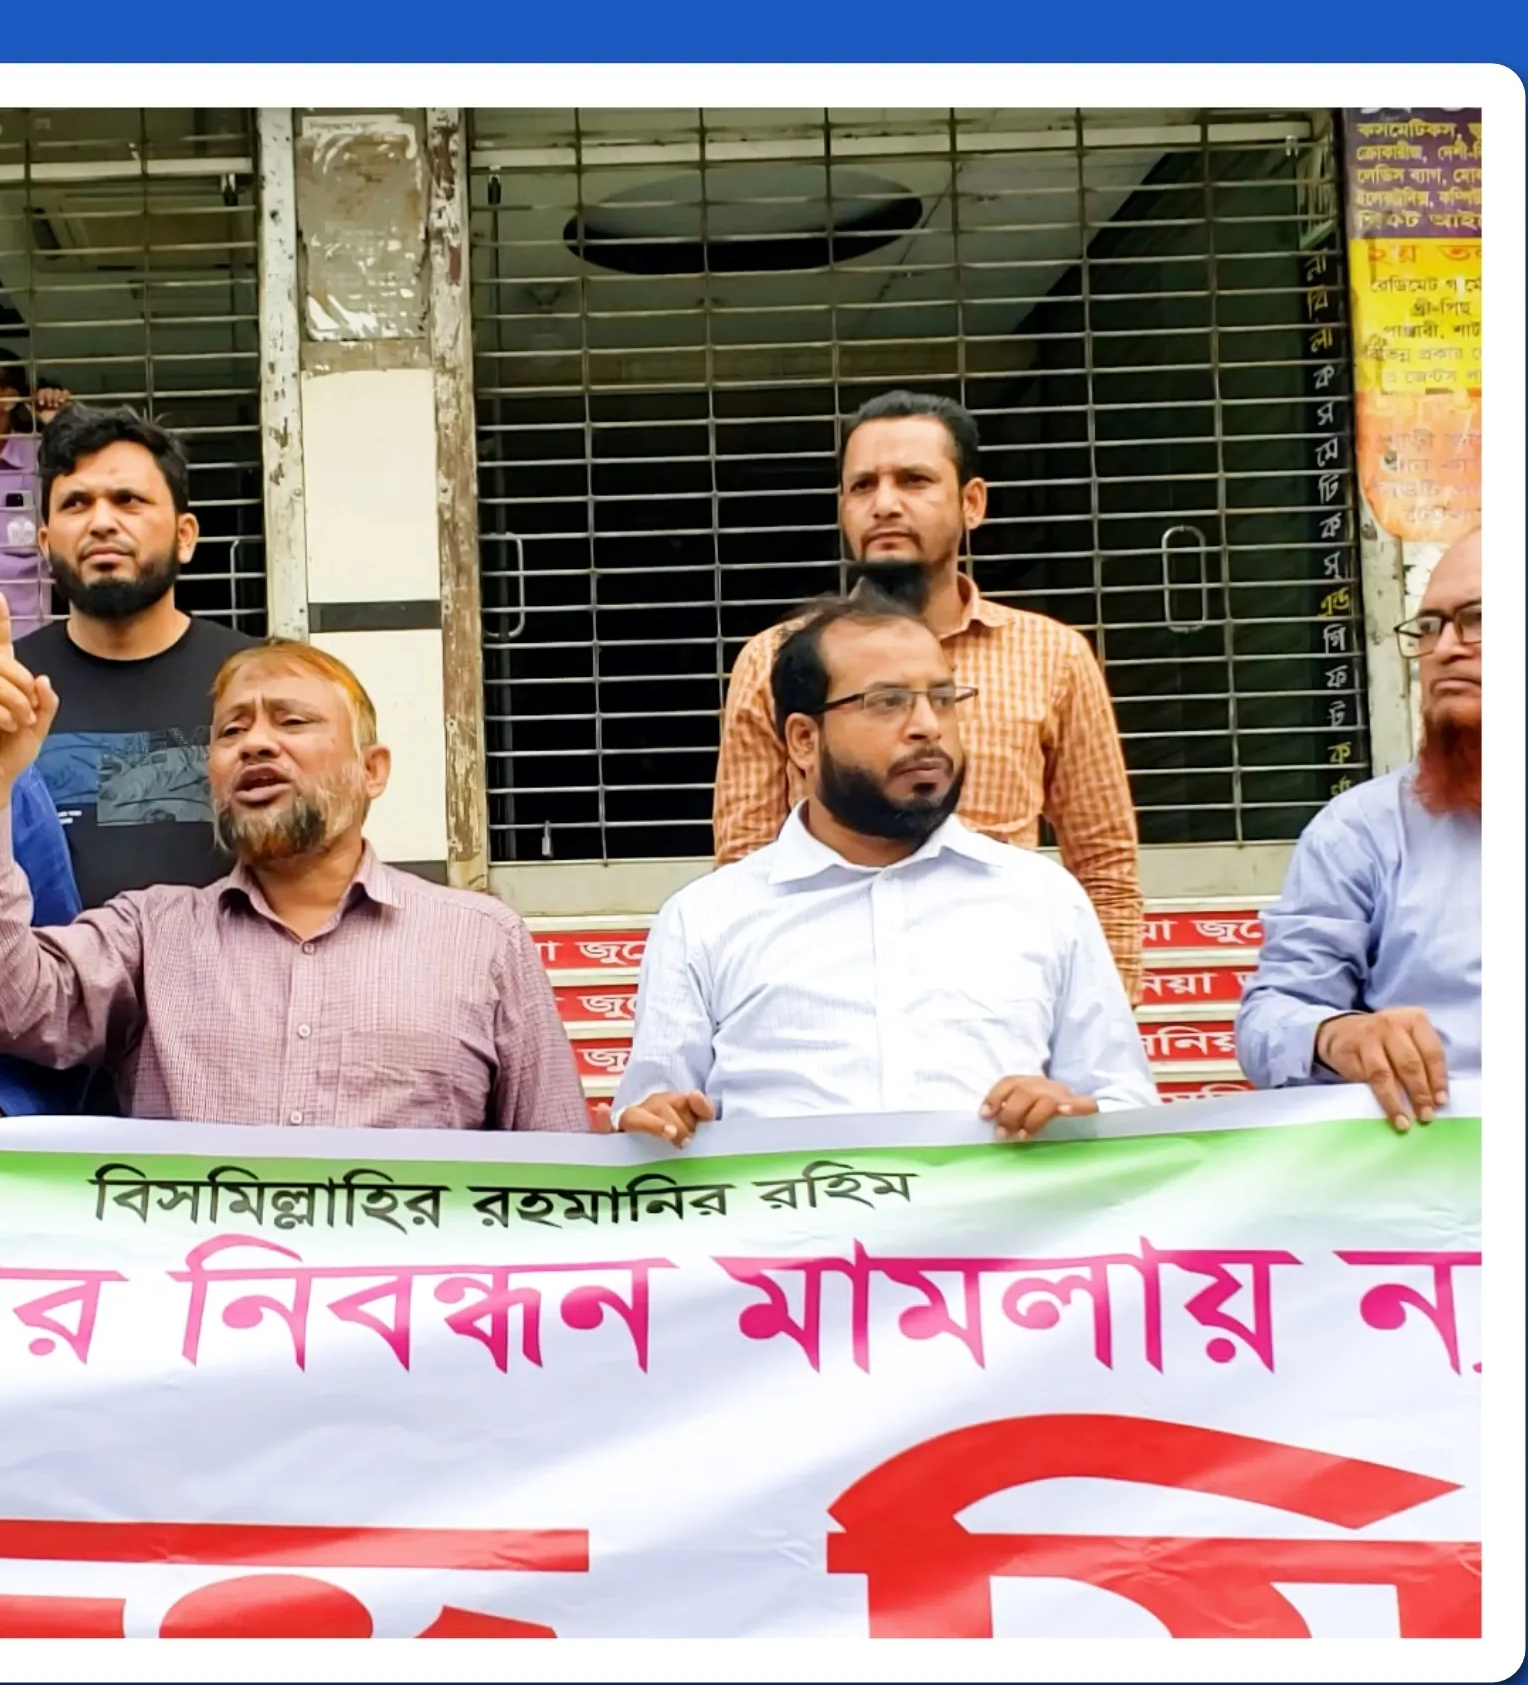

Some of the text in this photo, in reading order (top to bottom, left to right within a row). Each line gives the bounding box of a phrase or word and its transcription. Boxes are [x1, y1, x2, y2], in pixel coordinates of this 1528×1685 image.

[88, 1160, 921, 1233] বিসমিল্লাহির রহমানির রহিম
[167, 1233, 679, 1375] নিবন্ধন
[711, 1234, 1305, 1376] মামলায়
